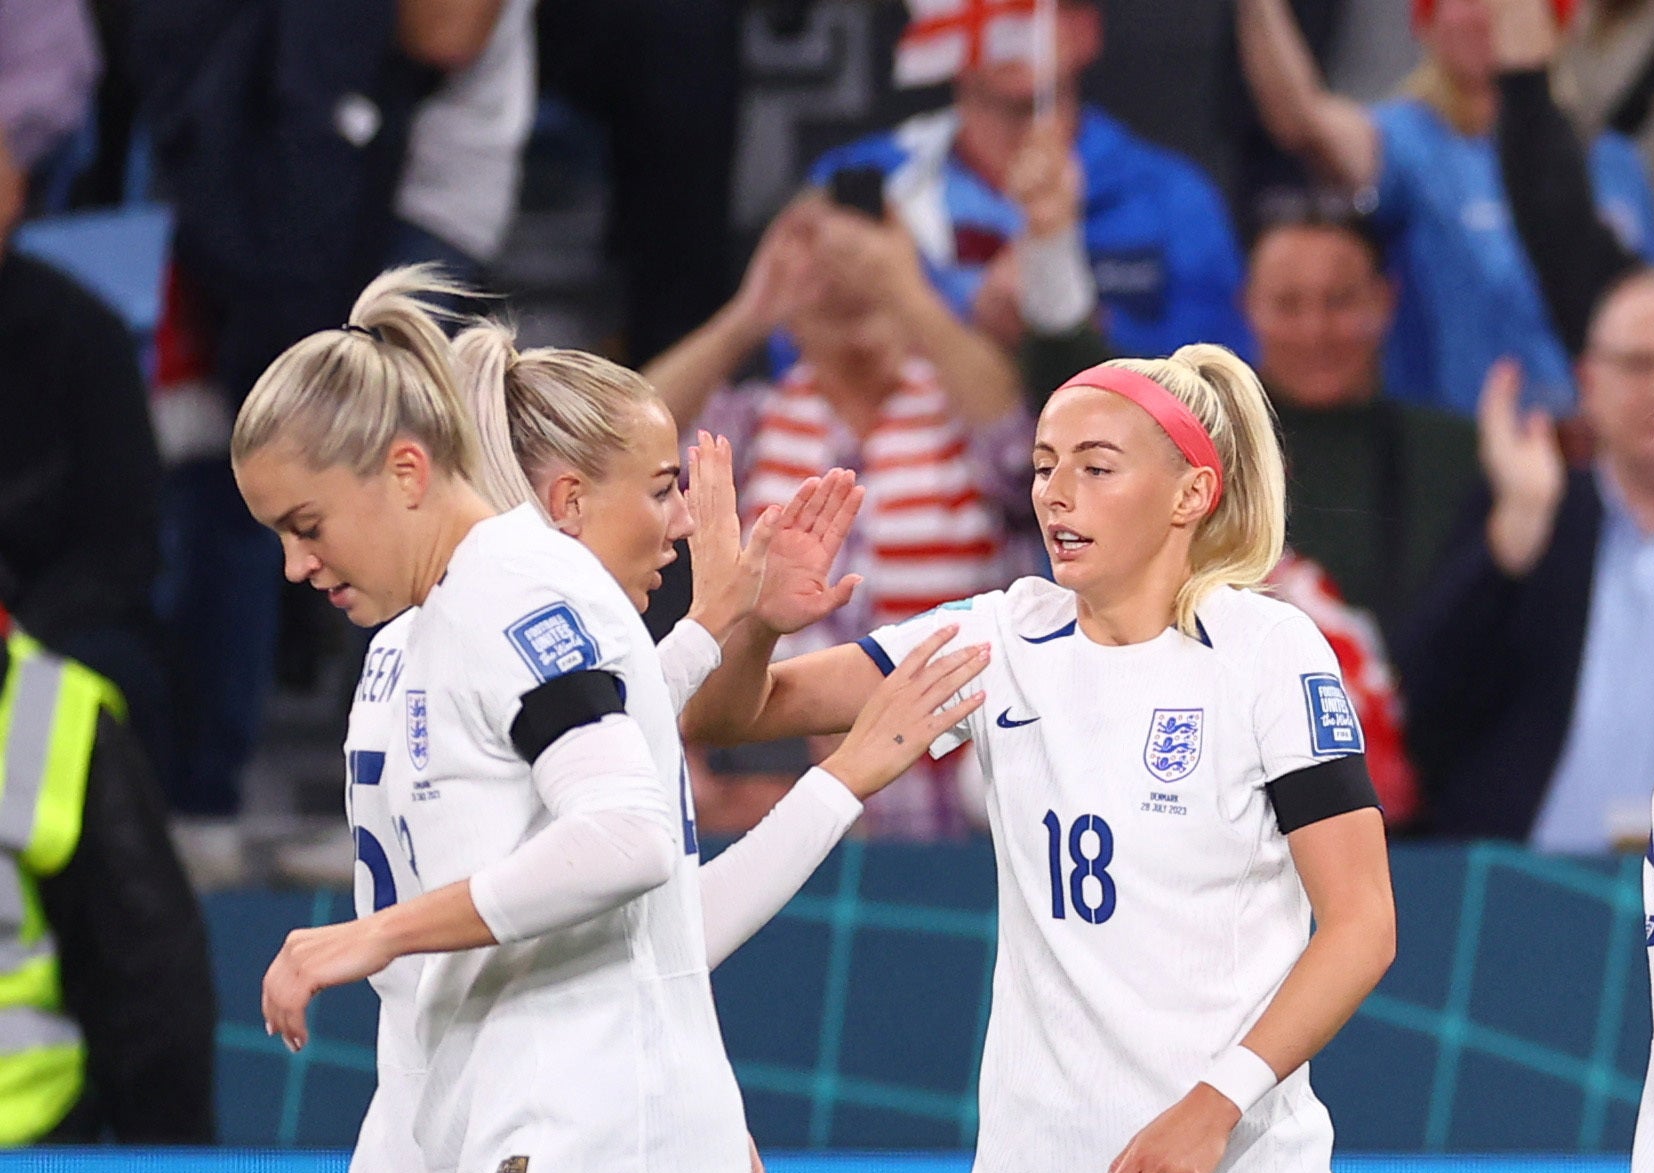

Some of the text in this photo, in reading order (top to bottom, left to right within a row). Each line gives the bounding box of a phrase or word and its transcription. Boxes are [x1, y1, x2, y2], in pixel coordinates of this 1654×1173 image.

[1150, 791, 1178, 802] DENMARK
[1152, 803, 1167, 813] JULY
[1168, 805, 1187, 815] 2023
[1042, 808, 1117, 924] 18
